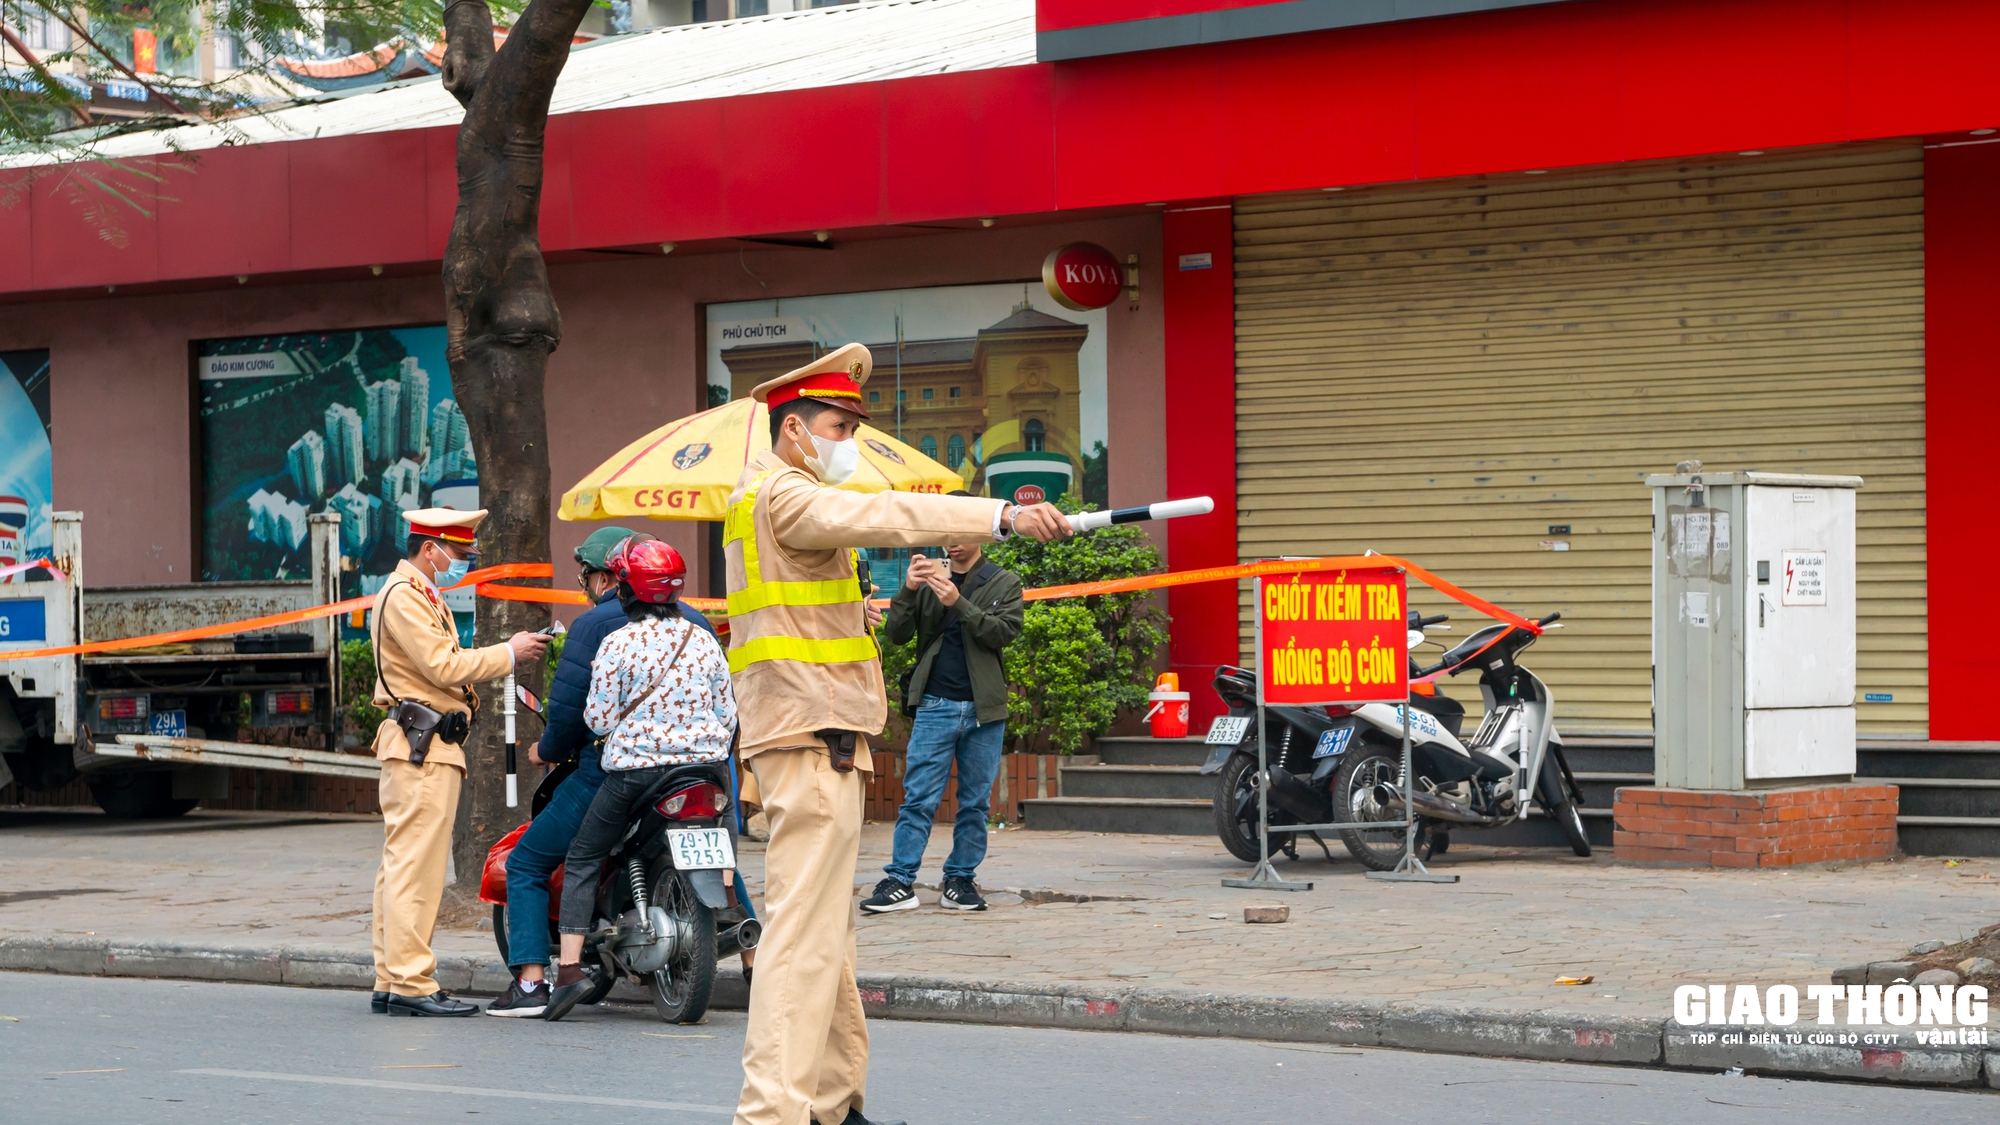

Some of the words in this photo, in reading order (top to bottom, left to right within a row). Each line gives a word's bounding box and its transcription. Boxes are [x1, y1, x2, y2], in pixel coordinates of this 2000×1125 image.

[1063, 263, 1119, 285] KOVA
[722, 325, 742, 340] PHỦ
[743, 323, 764, 338] CHỦ
[765, 324, 787, 339] TỊCH
[211, 360, 229, 373] ĐẢO
[229, 361, 245, 371] KIM
[634, 489, 702, 509] CSGT
[1018, 491, 1042, 500] KOVA
[1182, 572, 1203, 582] GIAO
[1265, 572, 1312, 621] CHỐT
[1315, 569, 1361, 621] KIỂM
[1366, 584, 1401, 621] TRA
[1272, 635, 1324, 686] NỒNG
[1326, 640, 1353, 692] ĐỘ
[1356, 635, 1396, 685] CỒN
[155, 712, 177, 730] 29A
[1208, 730, 1242, 742] 839.59
[1419, 724, 1437, 737] POLICE
[678, 831, 719, 849] 29-Y7
[681, 849, 725, 866] 5253
